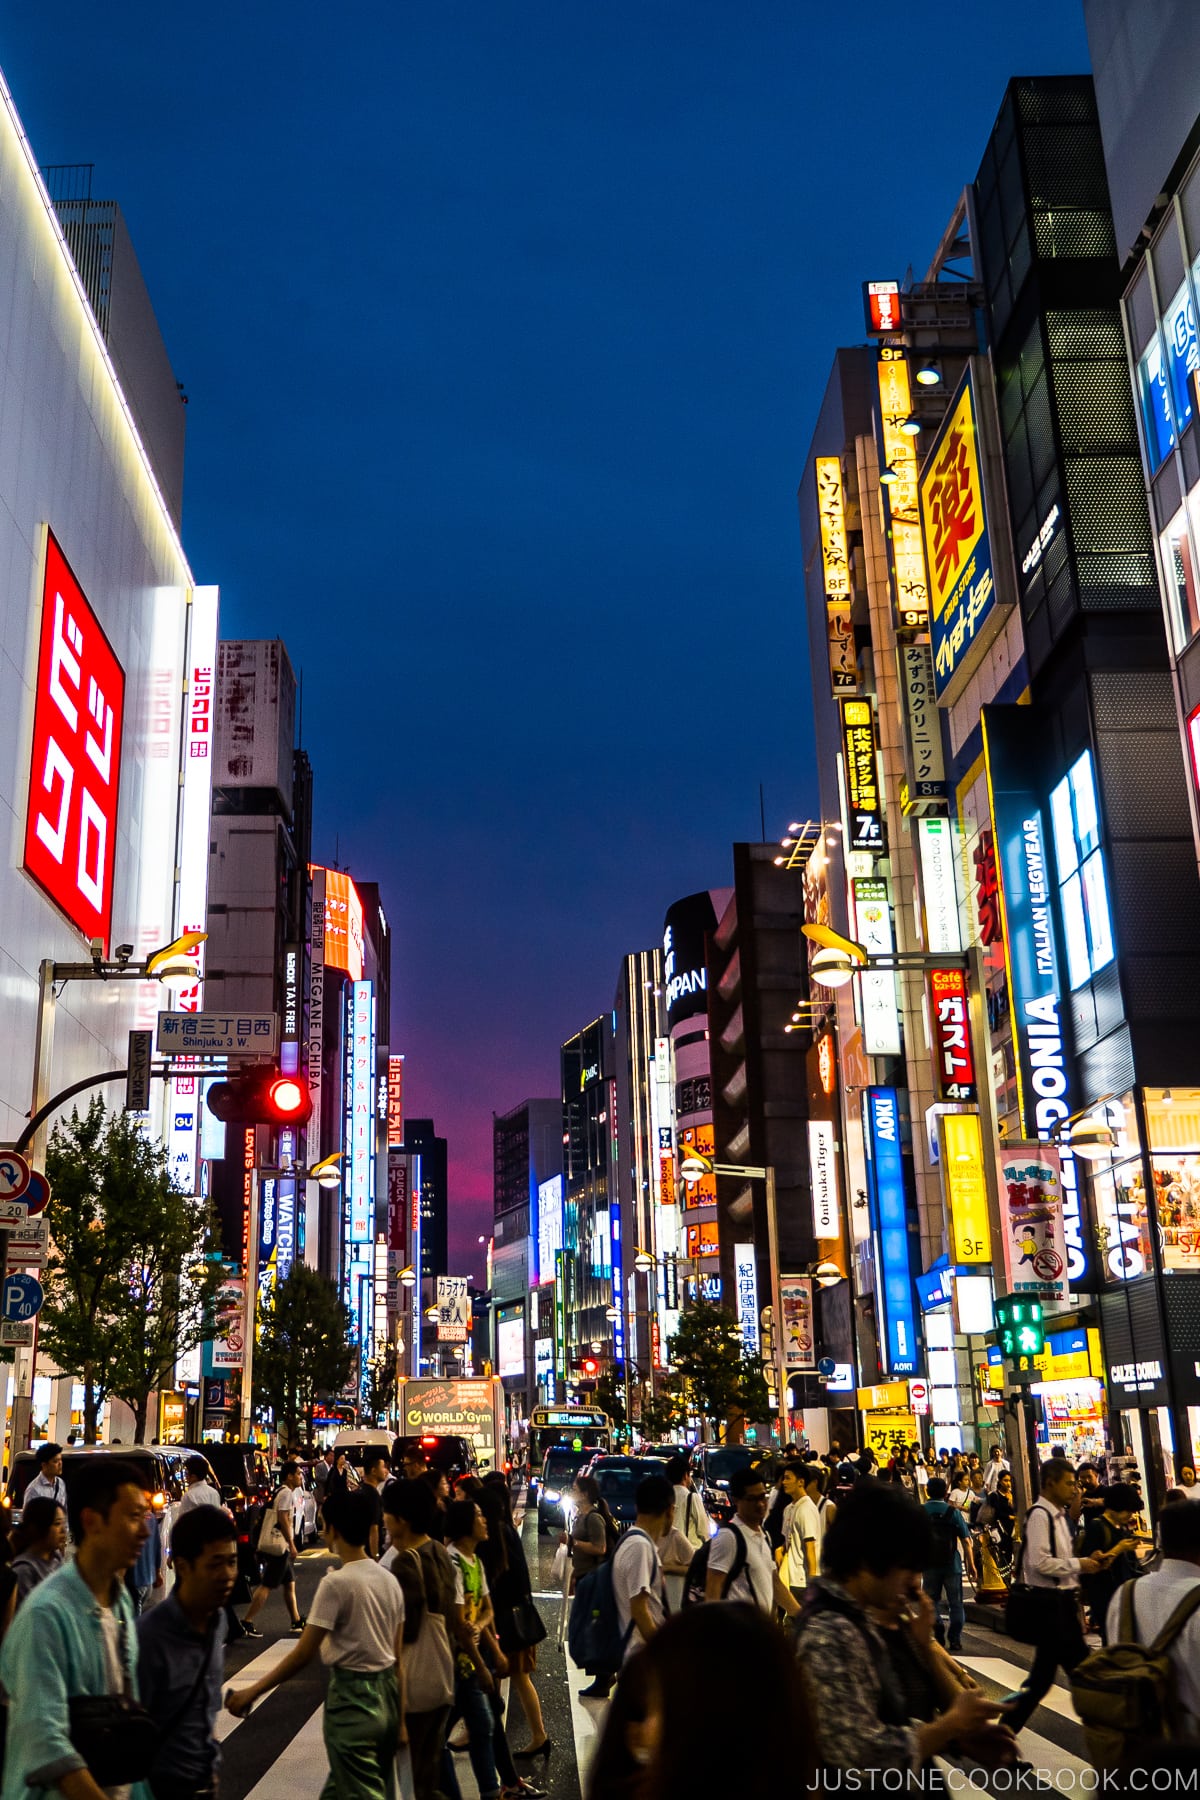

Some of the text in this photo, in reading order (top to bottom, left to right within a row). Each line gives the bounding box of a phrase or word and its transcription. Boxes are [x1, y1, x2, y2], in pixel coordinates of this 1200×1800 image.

[881, 348, 903, 361] 9F
[828, 579, 846, 589] 8F
[943, 586, 960, 625] DRUG
[905, 611, 928, 625] 9F
[837, 674, 853, 685] 7F
[192, 667, 211, 733] ビックロ
[907, 649, 932, 778] みずのクリニック
[854, 728, 877, 811] 北京ダック酒場
[922, 782, 940, 795] 8F
[856, 816, 880, 838] 7F
[1022, 819, 1053, 975] ITALIAN LEGWEAR
[933, 972, 961, 983] Café
[286, 986, 296, 1008] TAX
[162, 1018, 271, 1035] 新宿三丁目西
[286, 1010, 296, 1033] FREE
[309, 963, 323, 1091] MEGANE ICHIBA
[182, 1037, 250, 1048] Shinjuku 3 W.
[938, 997, 967, 1075] ガスト
[946, 1083, 969, 1099] 4F
[175, 1118, 193, 1127] GU
[877, 1099, 897, 1142] AOKI
[396, 1169, 405, 1201] QUICK
[819, 1131, 830, 1226] Onitsuka Tiger
[262, 1179, 274, 1244] Tax Free Shop
[963, 1239, 983, 1256] 3F
[438, 1279, 466, 1297] カラオケ
[6, 1286, 25, 1315] P
[19, 1303, 31, 1316] 40
[440, 1306, 464, 1325] 鉄人
[893, 1362, 913, 1371] AOKI
[870, 1430, 906, 1450] 改装
